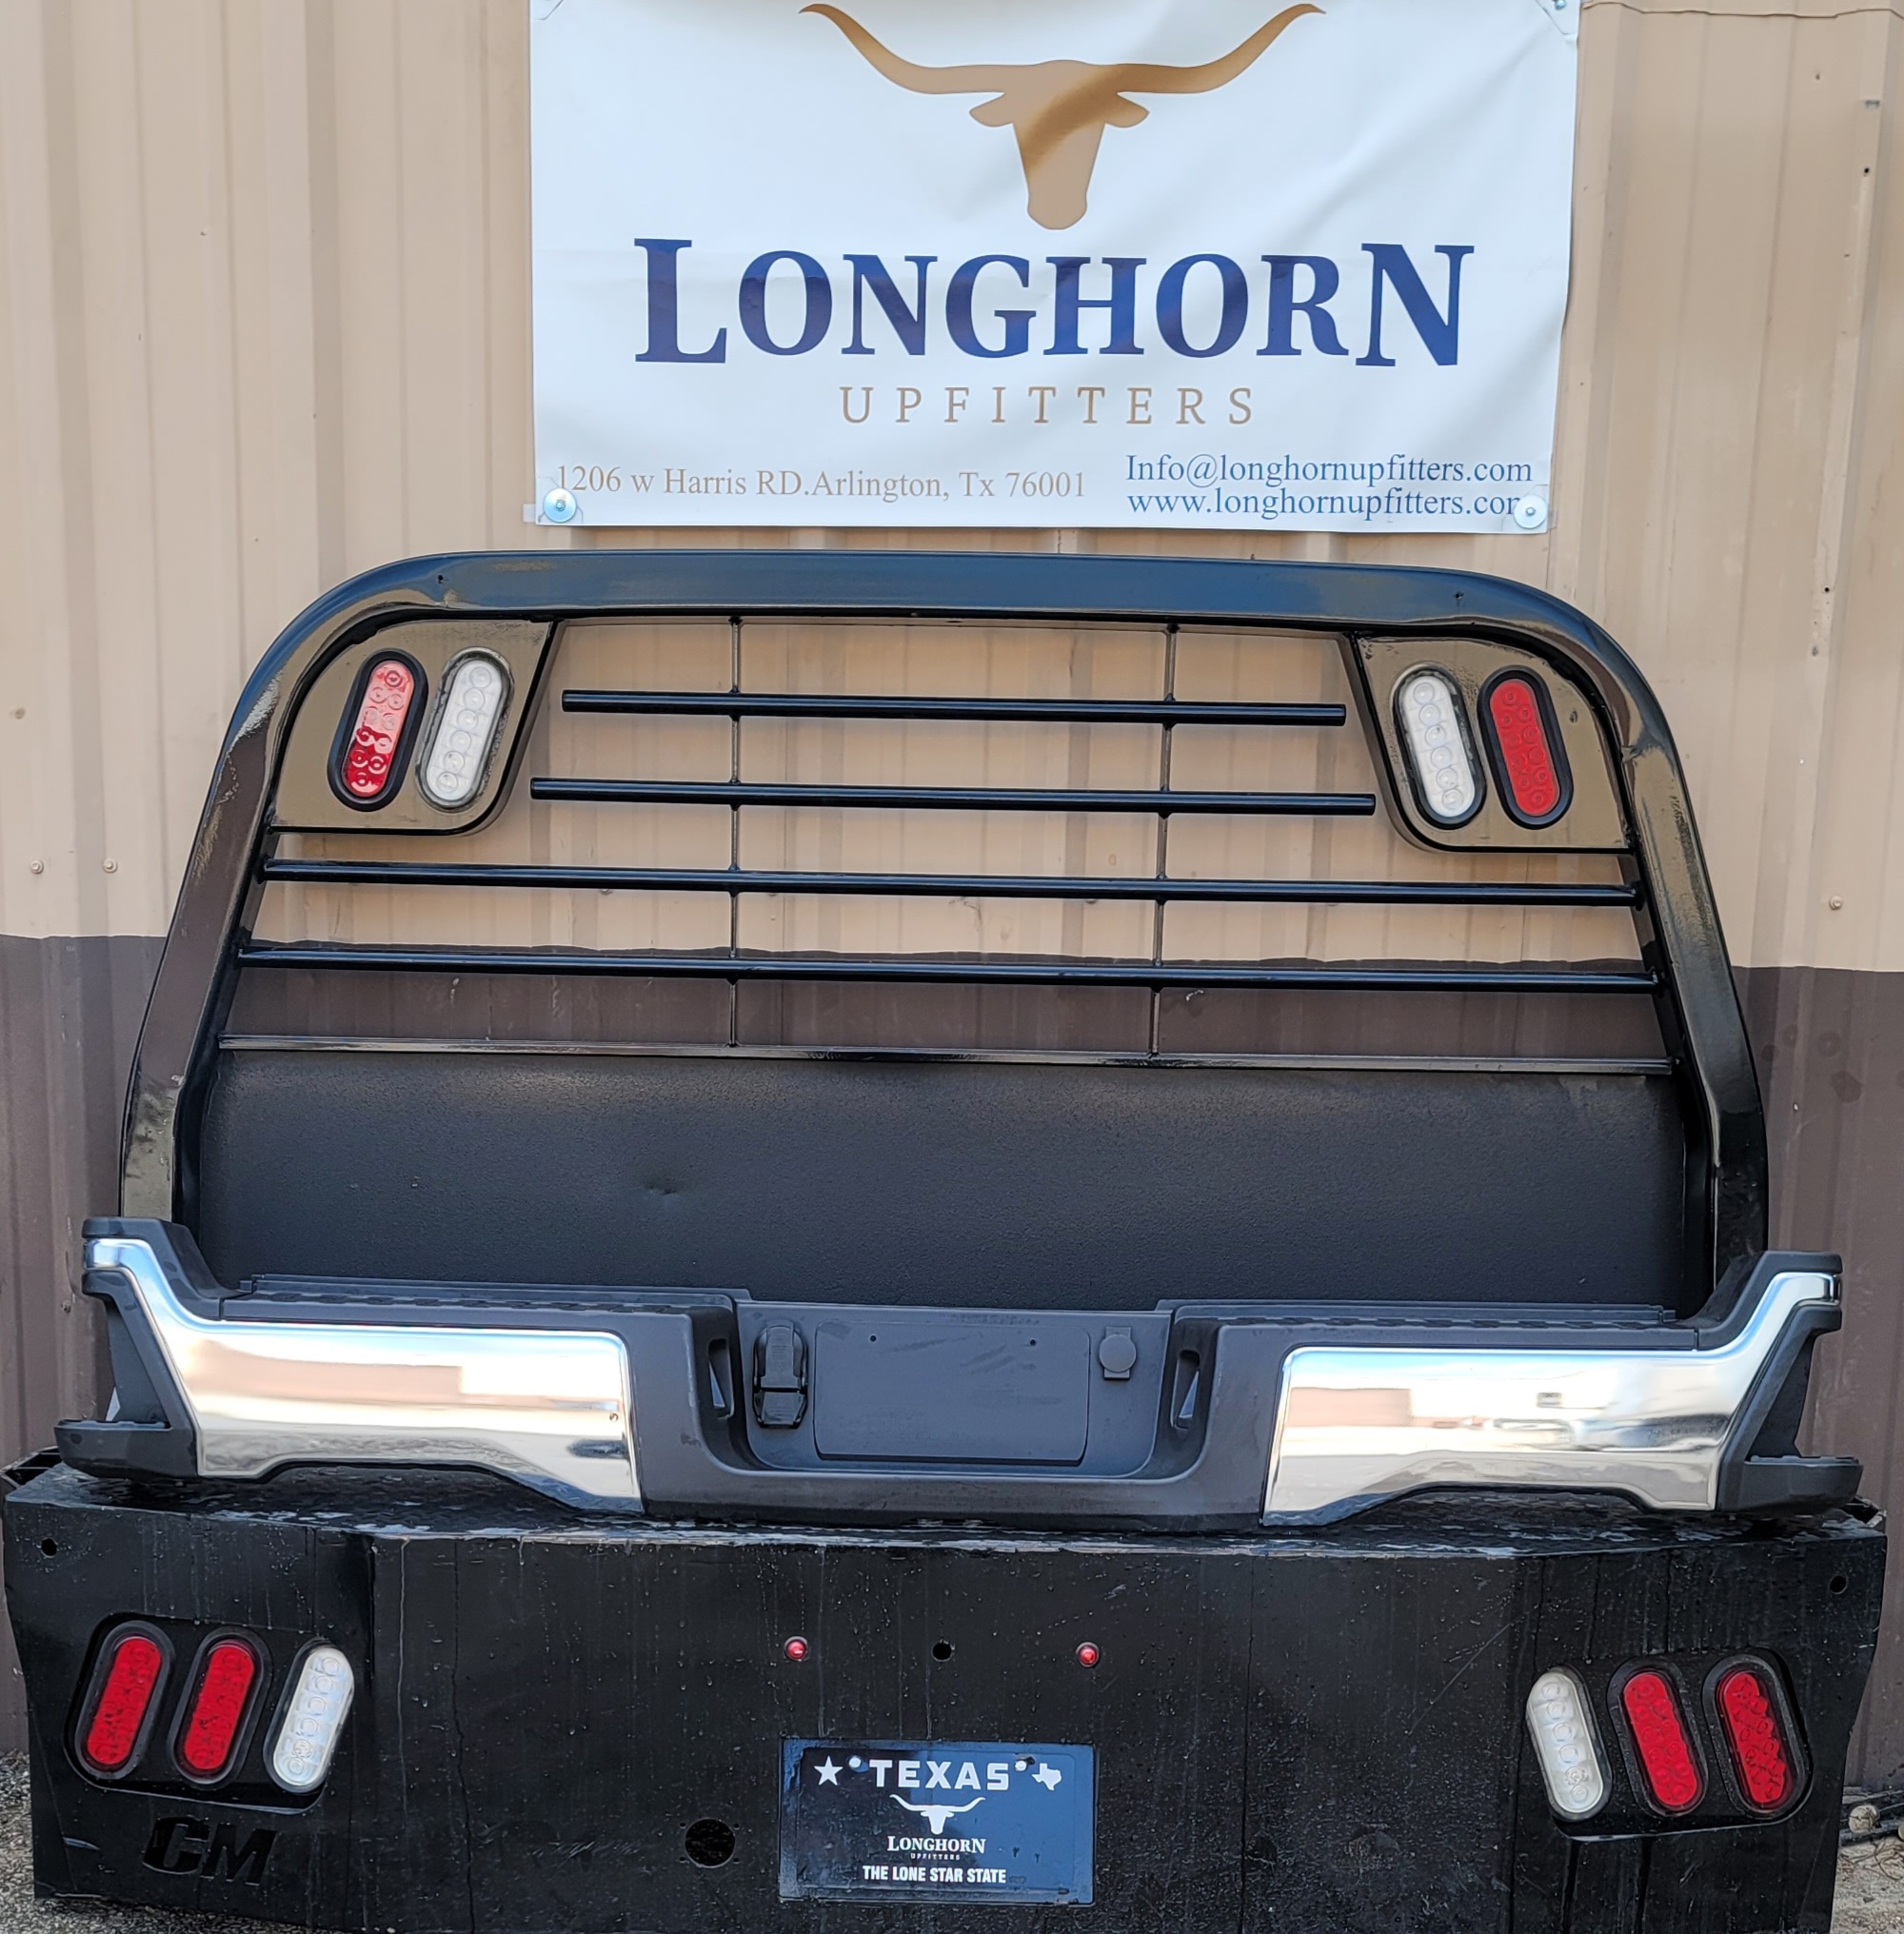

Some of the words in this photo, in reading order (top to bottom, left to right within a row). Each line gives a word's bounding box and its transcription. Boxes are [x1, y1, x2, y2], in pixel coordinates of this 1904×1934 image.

[633, 238, 1475, 366] LONGHORN
[840, 385, 1253, 425] UPFITTERS
[558, 464, 622, 493] 1206
[630, 474, 655, 493] w
[663, 468, 747, 495] Harris
[959, 471, 996, 498] Tx
[1004, 471, 1084, 498] 76001
[1125, 453, 1534, 489] Info@longhornupfitters.com
[869, 1759, 1010, 1790] TEXAS
[142, 1816, 278, 1886] CM
[886, 1835, 986, 1854] LONGHORN
[910, 1852, 961, 1861] UPFITTERS
[863, 1865, 888, 1881] THE
[892, 1865, 926, 1882] LONE
[930, 1867, 963, 1883] STAR
[967, 1868, 1007, 1884] STATE
